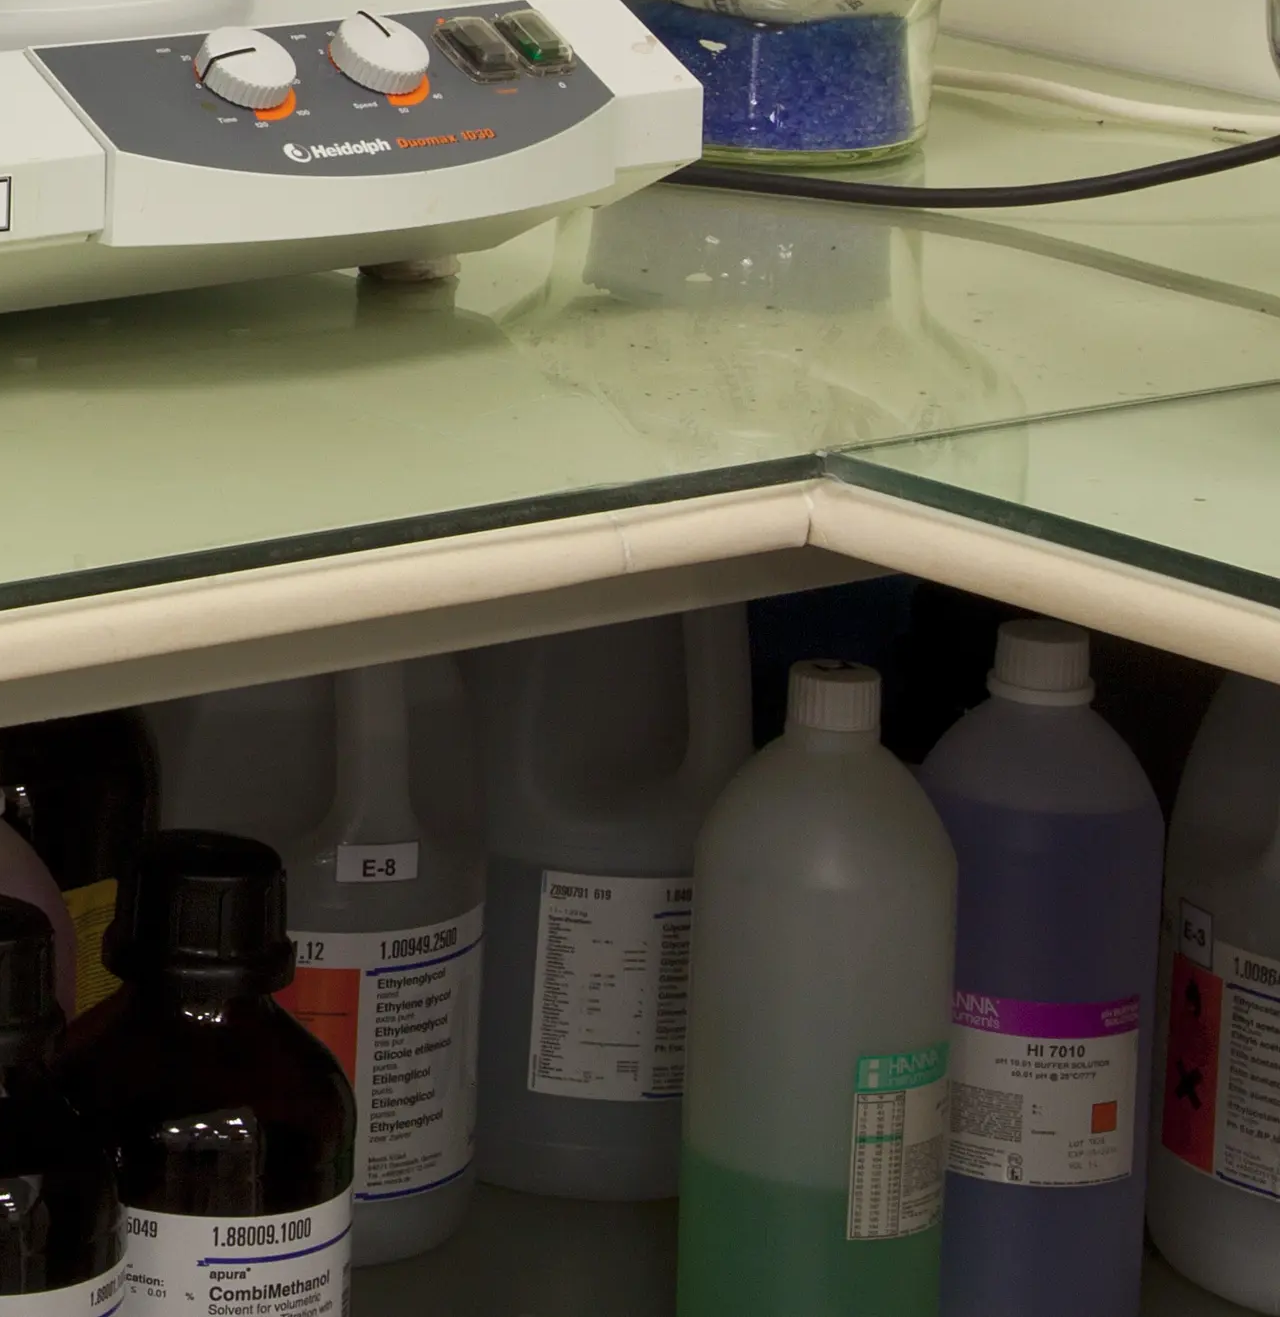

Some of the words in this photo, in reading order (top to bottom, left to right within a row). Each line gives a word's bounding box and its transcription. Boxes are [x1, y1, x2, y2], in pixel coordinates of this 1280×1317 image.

[310, 136, 393, 160] Heidolph
[362, 857, 397, 878] E-8
[1183, 919, 1206, 947] E-3
[1027, 1042, 1044, 1058] HI
[1049, 1044, 1086, 1059] 7010
[212, 1216, 312, 1248] 1.88009.1000
[208, 1269, 331, 1303] CombiMethanol
[207, 1302, 254, 1316] Solvent
[255, 1303, 272, 1314] for
